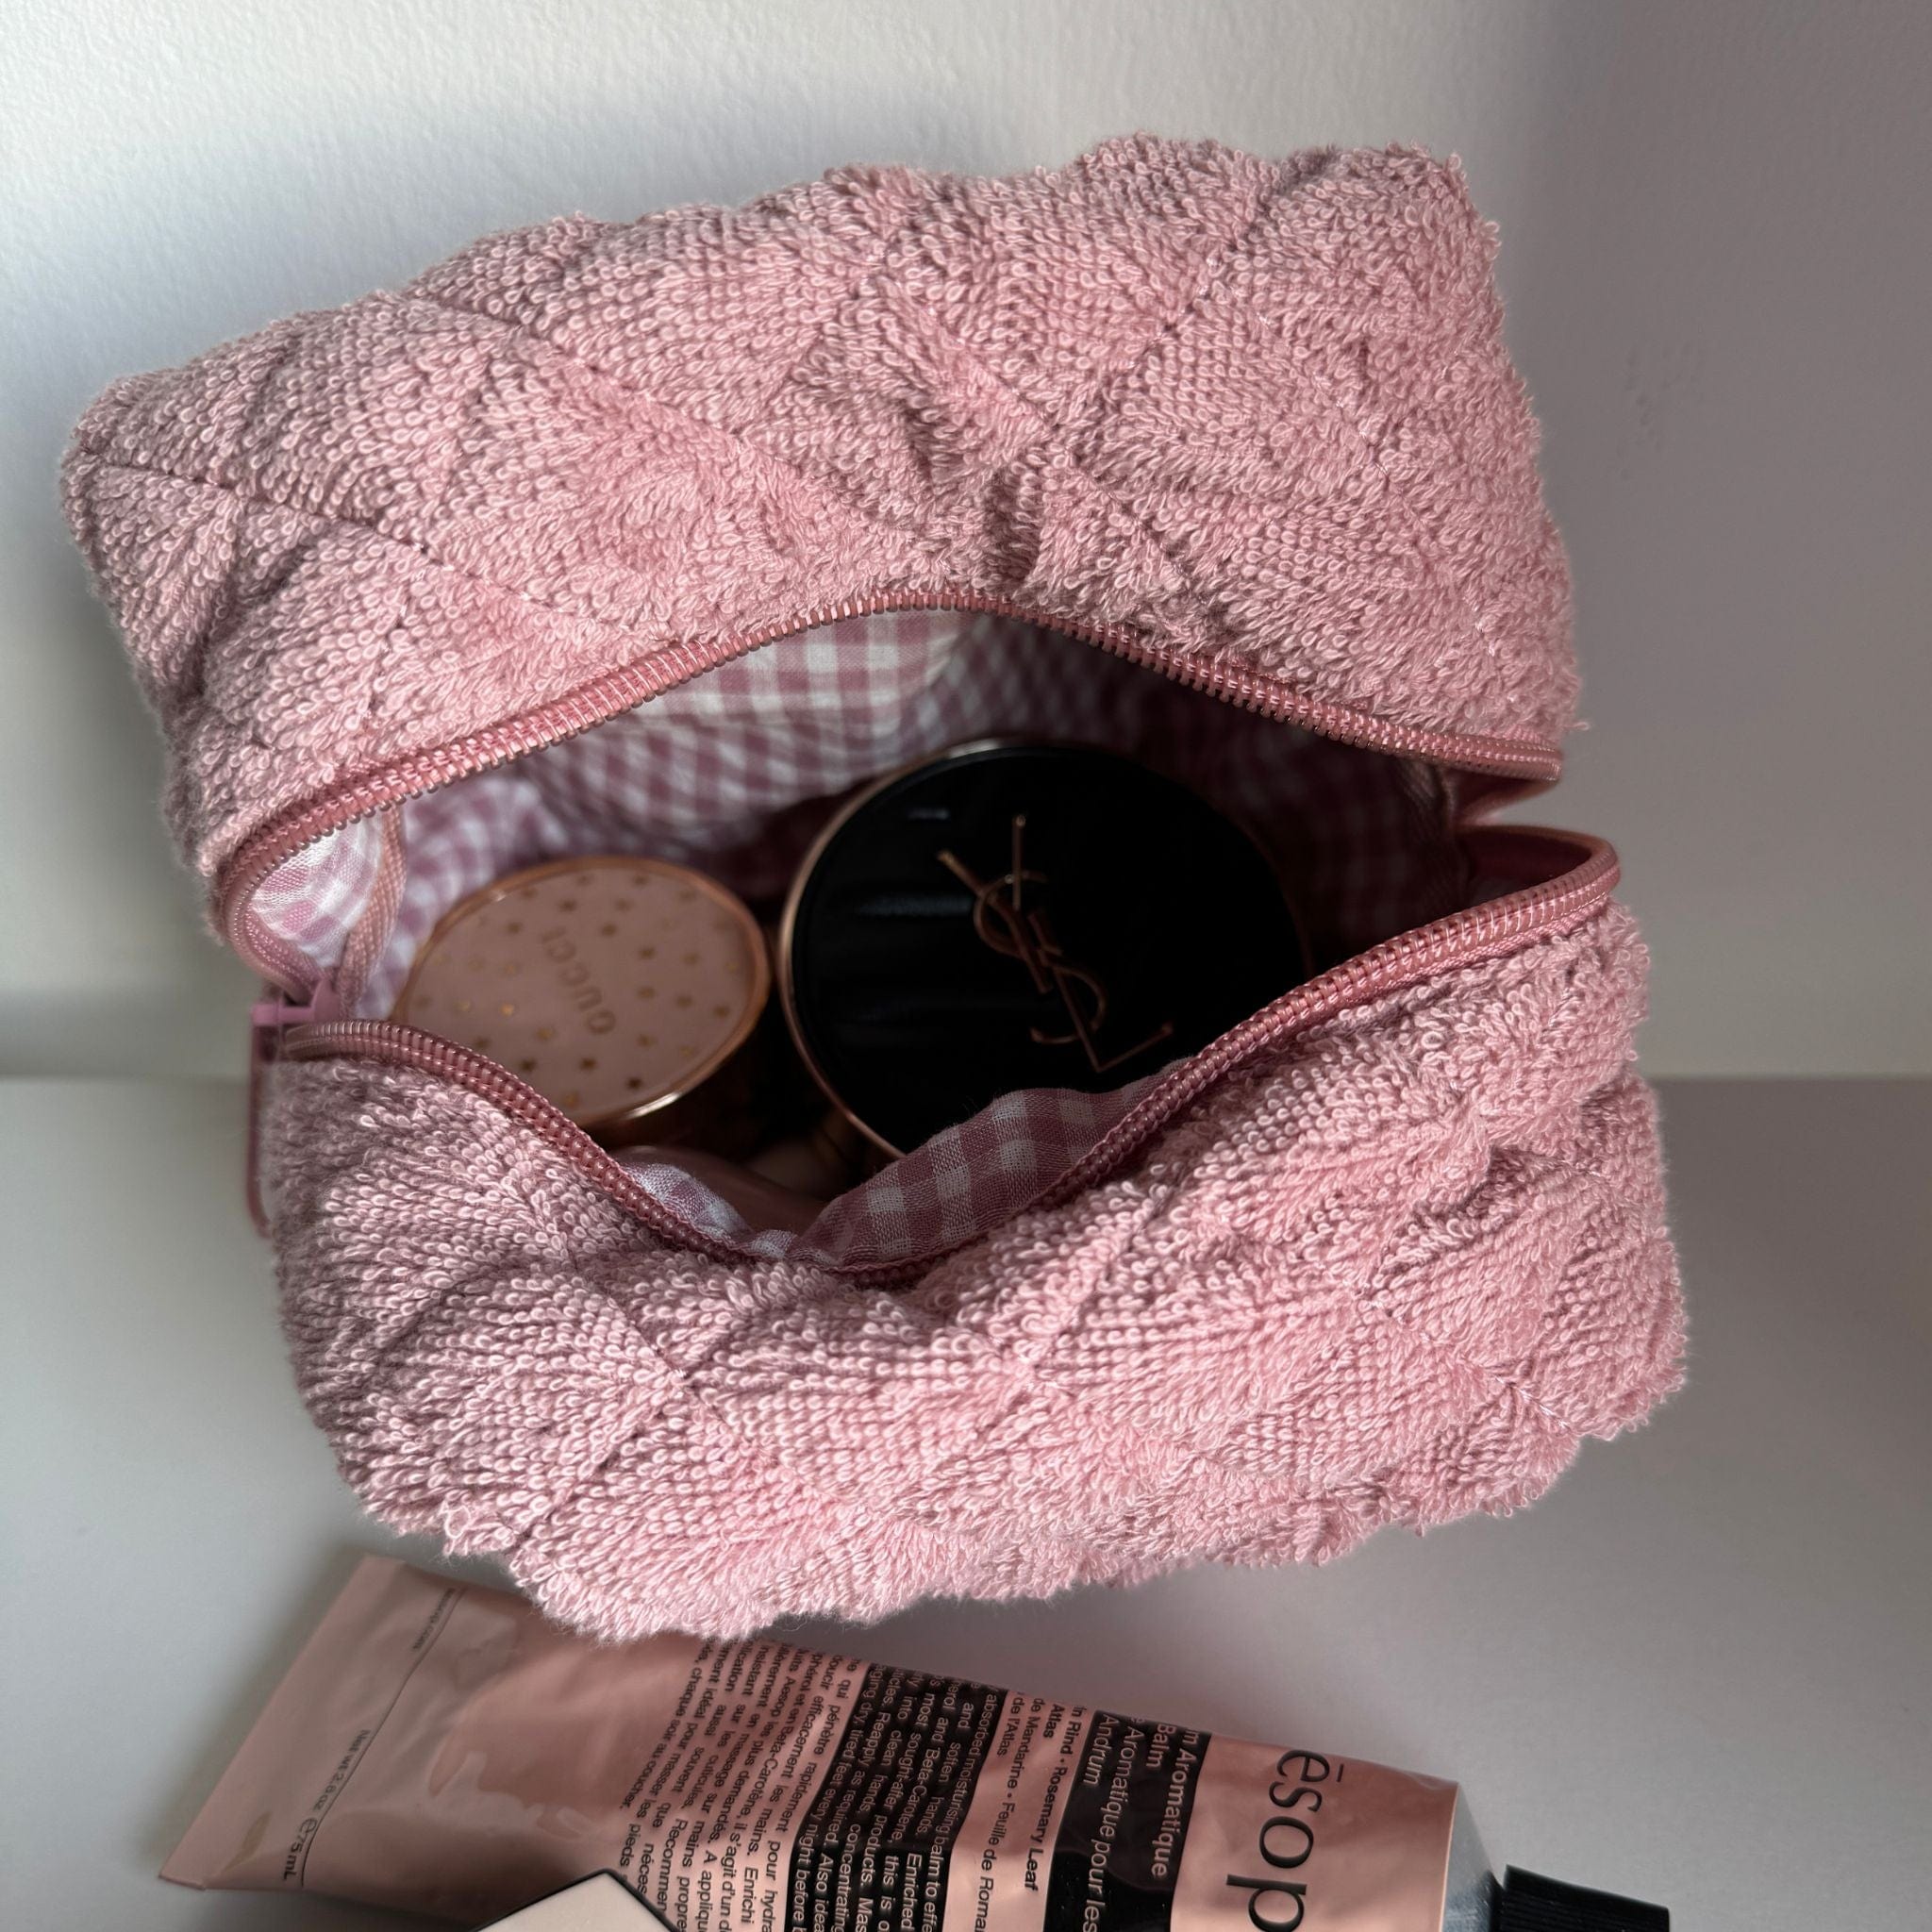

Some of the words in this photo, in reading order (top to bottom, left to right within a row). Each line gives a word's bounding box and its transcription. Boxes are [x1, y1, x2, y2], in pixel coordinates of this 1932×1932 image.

[541, 924, 616, 1036] GUCCI
[675, 1667, 703, 1717] chaque
[799, 1653, 823, 1691] phérol
[820, 1655, 843, 1690] doucir
[836, 1679, 851, 1699] qui
[693, 1688, 718, 1719] idéal
[730, 1704, 746, 1724] sur
[770, 1675, 796, 1718] Aesop
[785, 1707, 800, 1724] en
[793, 1693, 806, 1707] et
[853, 1702, 873, 1725] dry,
[897, 1696, 917, 1721] into
[914, 1692, 935, 1727] most
[957, 1702, 974, 1730] and
[1010, 1697, 1024, 1714] de
[1030, 1698, 1045, 1713] de
[662, 1719, 680, 1741] soir
[677, 1723, 699, 1750] pour
[704, 1705, 726, 1736] aussi
[717, 1730, 736, 1748] les
[746, 1713, 760, 1728] en
[759, 1721, 779, 1738] les
[781, 1696, 824, 1779] efficacement
[813, 1704, 841, 1756] pénètre
[858, 1711, 891, 1767] Reapply
[931, 1717, 949, 1743] and
[968, 1693, 997, 1757] absorbed
[996, 1718, 1020, 1757] l'Atlas
[1042, 1704, 1065, 1739] Atlas
[1059, 1721, 1082, 1755] Rind
[651, 1743, 667, 1759] au
[714, 1733, 750, 1788] massage
[744, 1740, 764, 1766] plus
[842, 1729, 864, 1759] tired
[880, 1730, 902, 1767] clean
[938, 1742, 961, 1783] soften
[1007, 1716, 1041, 1790] Mandarine
[1083, 1714, 1120, 1787] Andrum
[1145, 1724, 1176, 1768] Balm
[619, 1760, 657, 1809] coucher.
[649, 1753, 681, 1796] masser
[671, 1746, 705, 1793] souvent
[679, 1755, 719, 1809] cuticules.
[736, 1726, 794, 1819] Beta-Carotène,
[829, 1761, 851, 1787] feet
[851, 1771, 865, 1786] as
[883, 1732, 922, 1810] sought-after
[1099, 1726, 1144, 1838] Aromatique
[636, 1799, 655, 1819] les
[701, 1793, 718, 1814] sur
[707, 1770, 749, 1844] demandés.
[769, 1784, 790, 1803] les
[775, 1761, 818, 1832] rapidement
[809, 1789, 836, 1821] every
[856, 1774, 888, 1814] hands,
[887, 1749, 941, 1843] Beta-Carotene,
[935, 1757, 975, 1835] moisturising
[1030, 1767, 1068, 1843] Rosemary
[1151, 1748, 1197, 1877] Aromatique
[652, 1802, 672, 1828] que
[746, 1808, 773, 1857] mains.
[823, 1790, 857, 1847] required.
[915, 1796, 944, 1836] hands.
[988, 1802, 1016, 1846] Feuille
[620, 1824, 641, 1867] pieds
[682, 1821, 705, 1868] mains
[703, 1850, 718, 1864] A
[766, 1840, 781, 1881] pour
[797, 1824, 819, 1865] night
[860, 1814, 888, 1887] products.
[927, 1836, 949, 1877] balm
[981, 1849, 997, 1872] de
[283, 1855, 297, 1880] mL
[815, 1853, 834, 1892] Also
[830, 1824, 861, 1932] concentrating
[882, 1856, 899, 1887] this
[1024, 1848, 1043, 1891] Leaf
[1088, 1839, 1111, 1895] pour
[675, 1875, 691, 1932] propre
[695, 1870, 712, 1932] appliqu
[741, 1866, 758, 1924] Enrichi
[792, 1869, 810, 1923] before
[880, 1895, 896, 1911] is
[900, 1853, 923, 1930] Enriched
[924, 1881, 940, 1899] to
[974, 1876, 993, 1932] Roma
[1082, 1899, 1106, 1932] les
